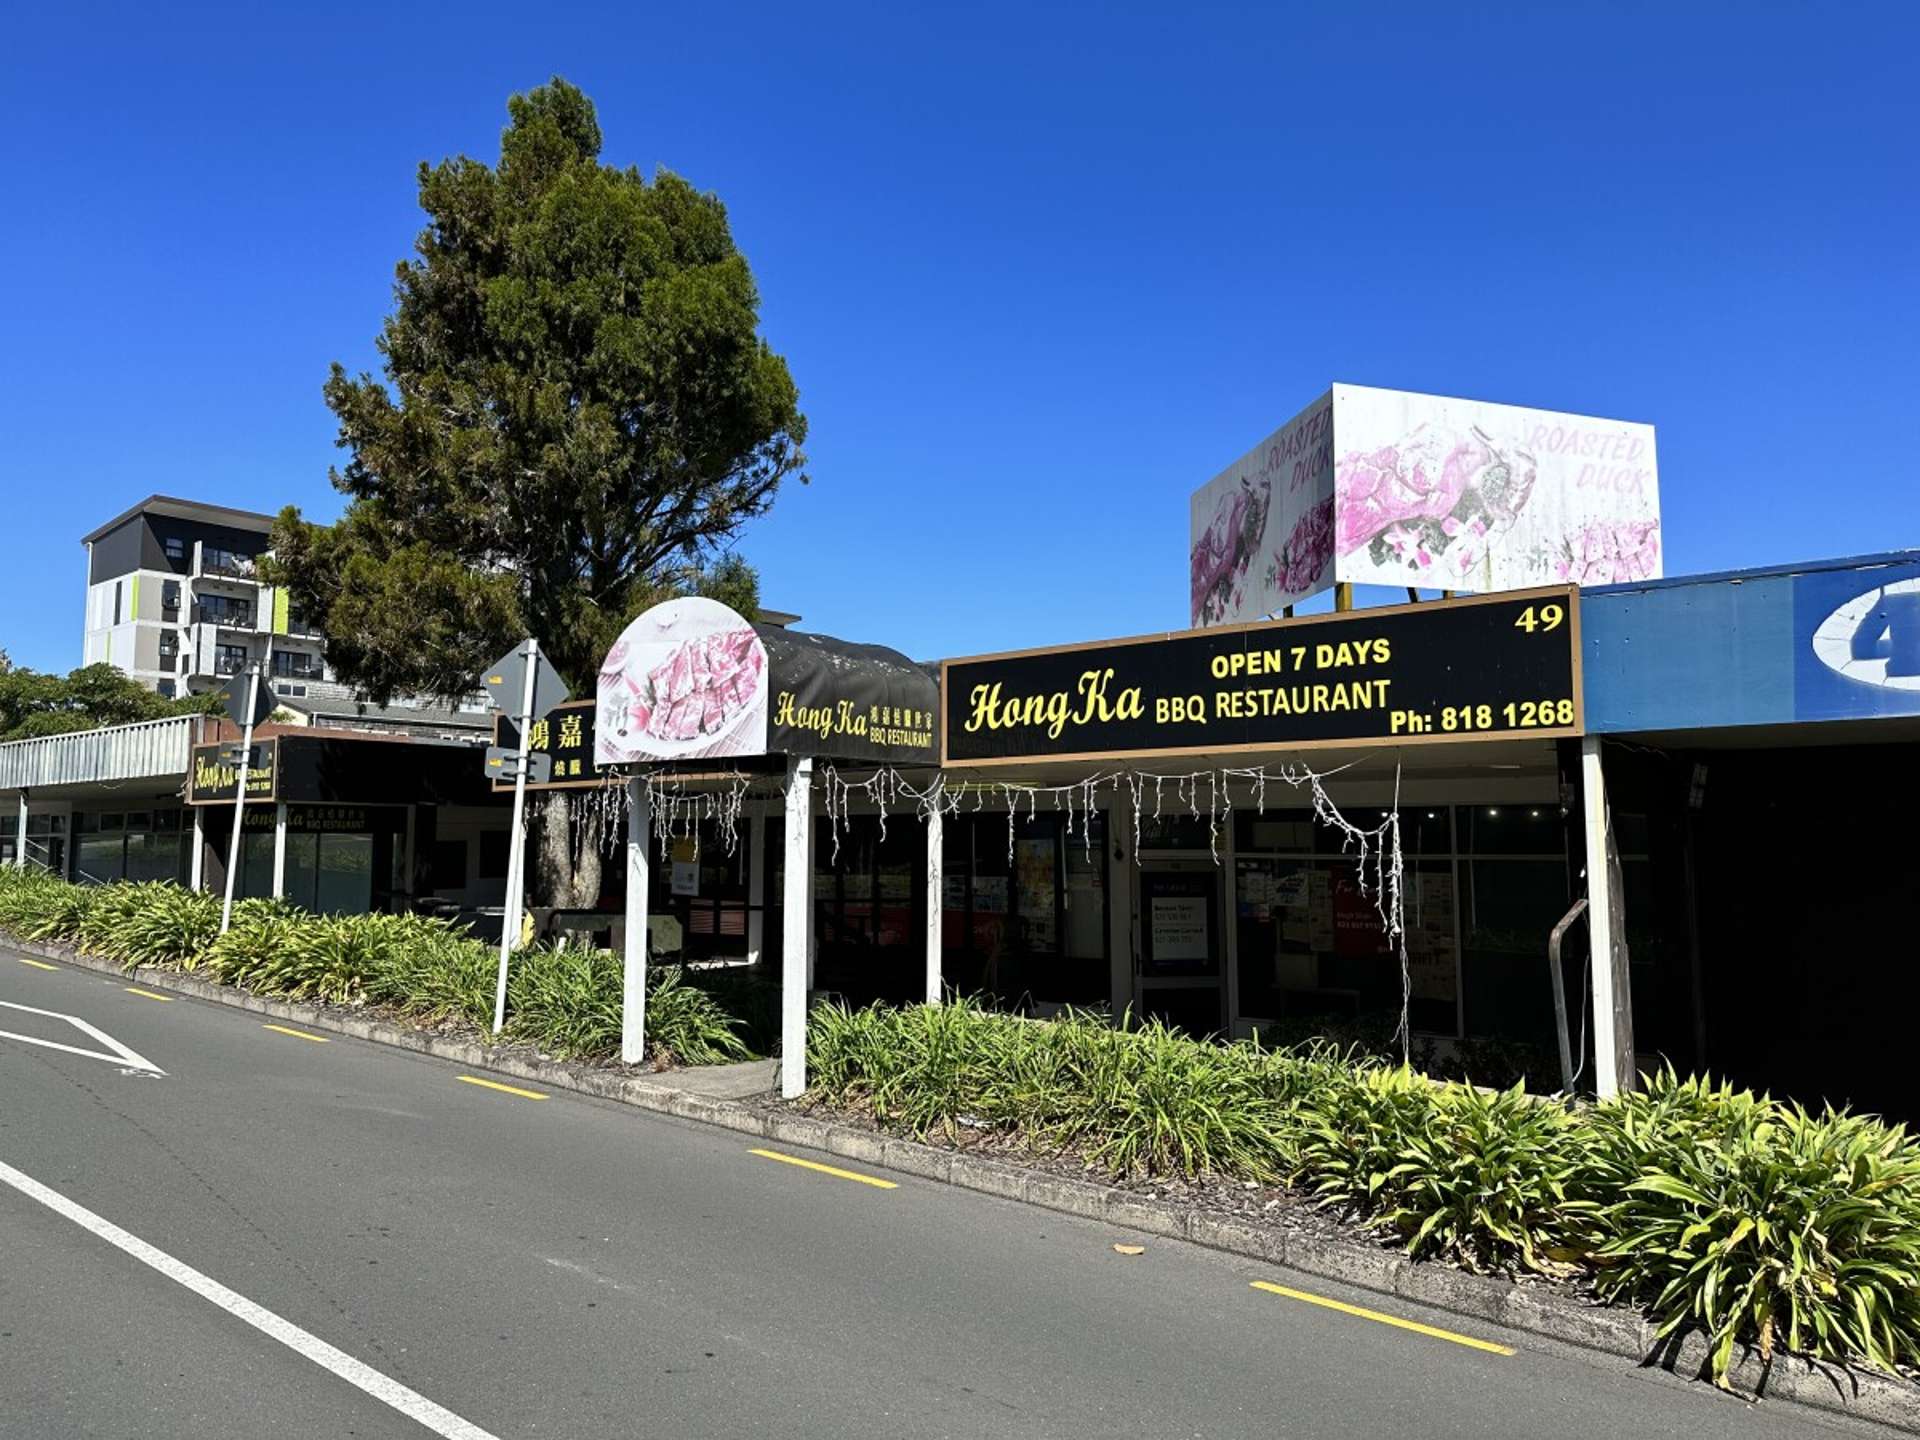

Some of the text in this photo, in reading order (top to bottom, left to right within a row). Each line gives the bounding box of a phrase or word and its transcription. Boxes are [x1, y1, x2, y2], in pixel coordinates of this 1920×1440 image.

[1529, 423, 1644, 463] ROASTED
[1576, 463, 1651, 494] DUCK
[1515, 603, 1564, 633] 49
[1211, 638, 1392, 679] OPEN 7 DAYS
[965, 667, 1146, 740] Hong Ka
[1155, 678, 1392, 724] BBQ RESTAURANT
[1390, 699, 1576, 735] Ph: 818 1268
[870, 726, 933, 749] BBQ RESTAURANT
